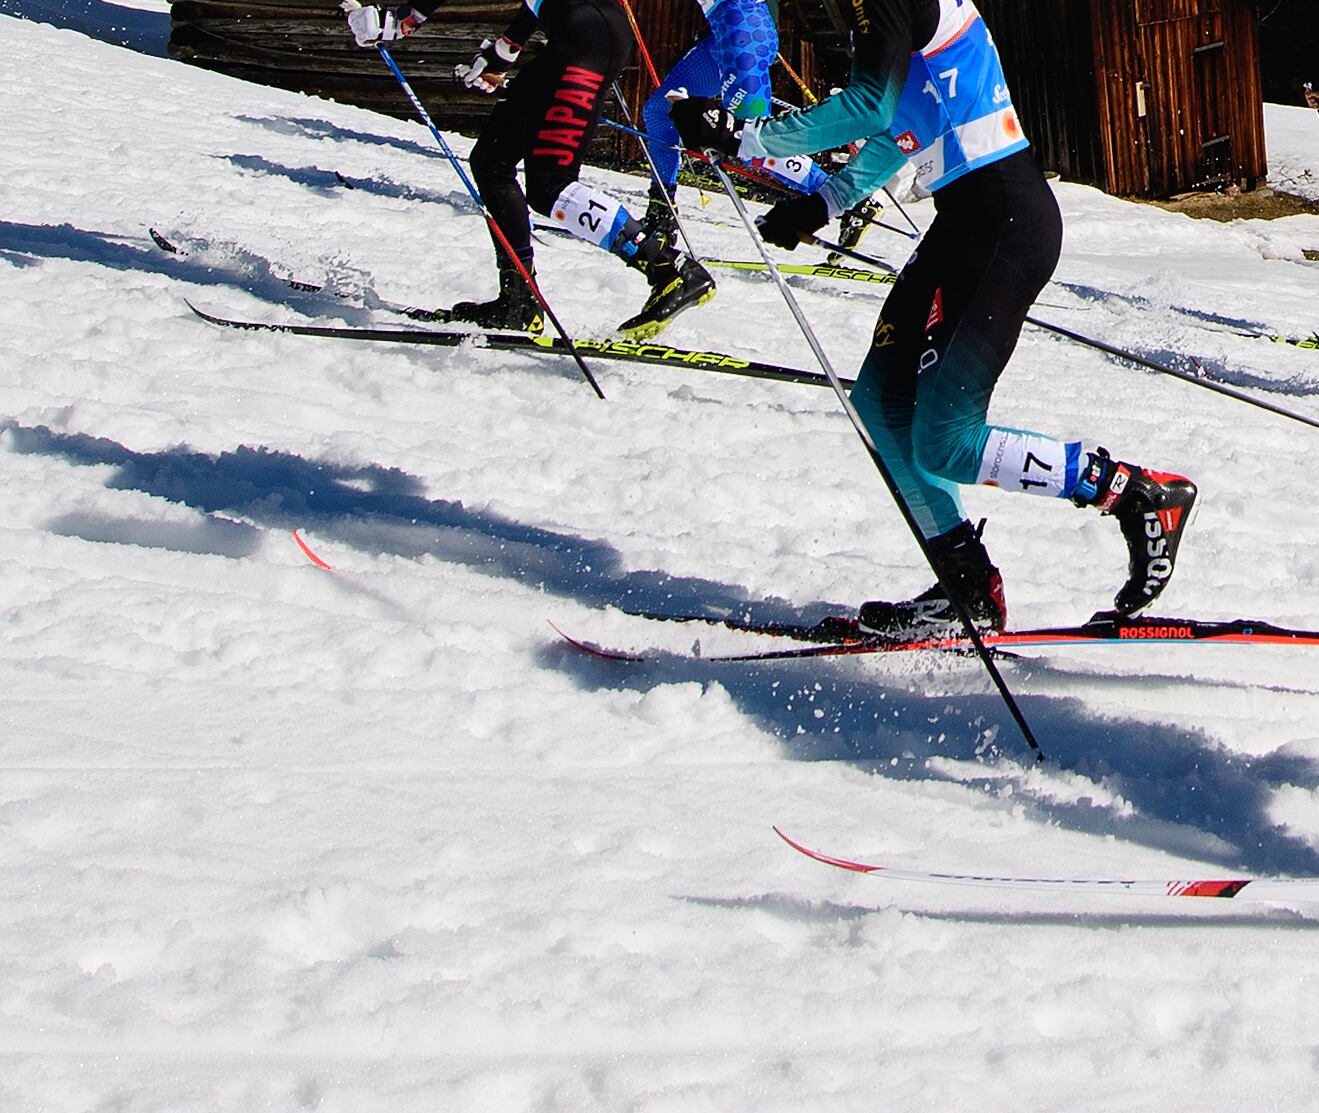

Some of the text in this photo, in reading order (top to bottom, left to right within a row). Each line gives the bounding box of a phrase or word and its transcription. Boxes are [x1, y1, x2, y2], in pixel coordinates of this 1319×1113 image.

[923, 68, 959, 104] 17
[533, 65, 605, 167] JAPAN
[578, 199, 608, 233] 21
[574, 339, 750, 369] FISCHER
[1019, 451, 1053, 490] 17
[1119, 626, 1195, 639] ROSSIGNOL
